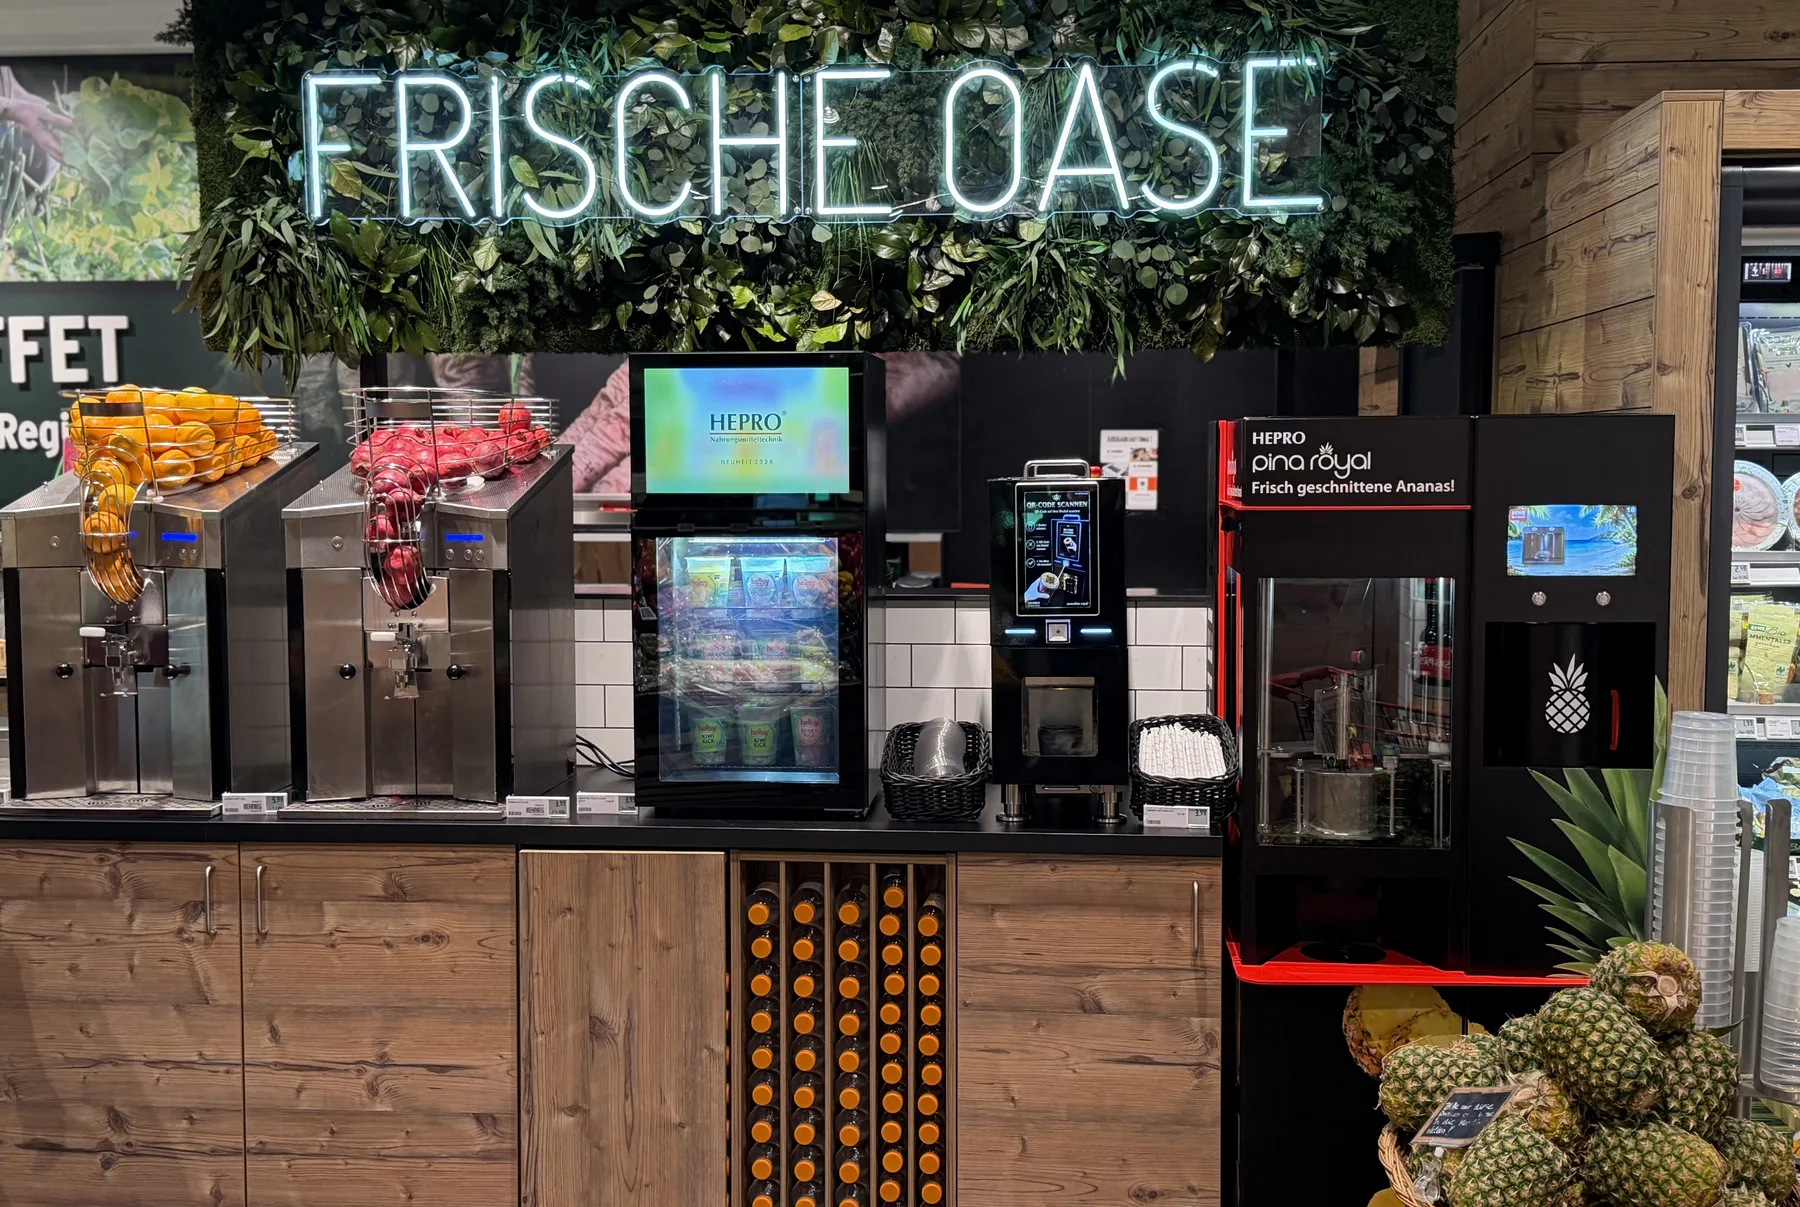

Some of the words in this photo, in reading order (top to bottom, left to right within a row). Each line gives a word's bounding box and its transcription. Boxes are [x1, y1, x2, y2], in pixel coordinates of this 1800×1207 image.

[306, 69, 895, 220] FRISCHE
[942, 56, 1328, 215] OASE
[0, 315, 129, 383] FET
[710, 436, 783, 444] Nahrungsmitteltechnik
[1252, 431, 1306, 445] HEPRO
[1252, 453, 1304, 473] pina
[1310, 451, 1371, 479] royal
[1251, 480, 1294, 494] Frisch
[1297, 480, 1393, 497] geschnittene
[1396, 479, 1455, 493] Ananas!
[1026, 501, 1056, 509] QR-CODE
